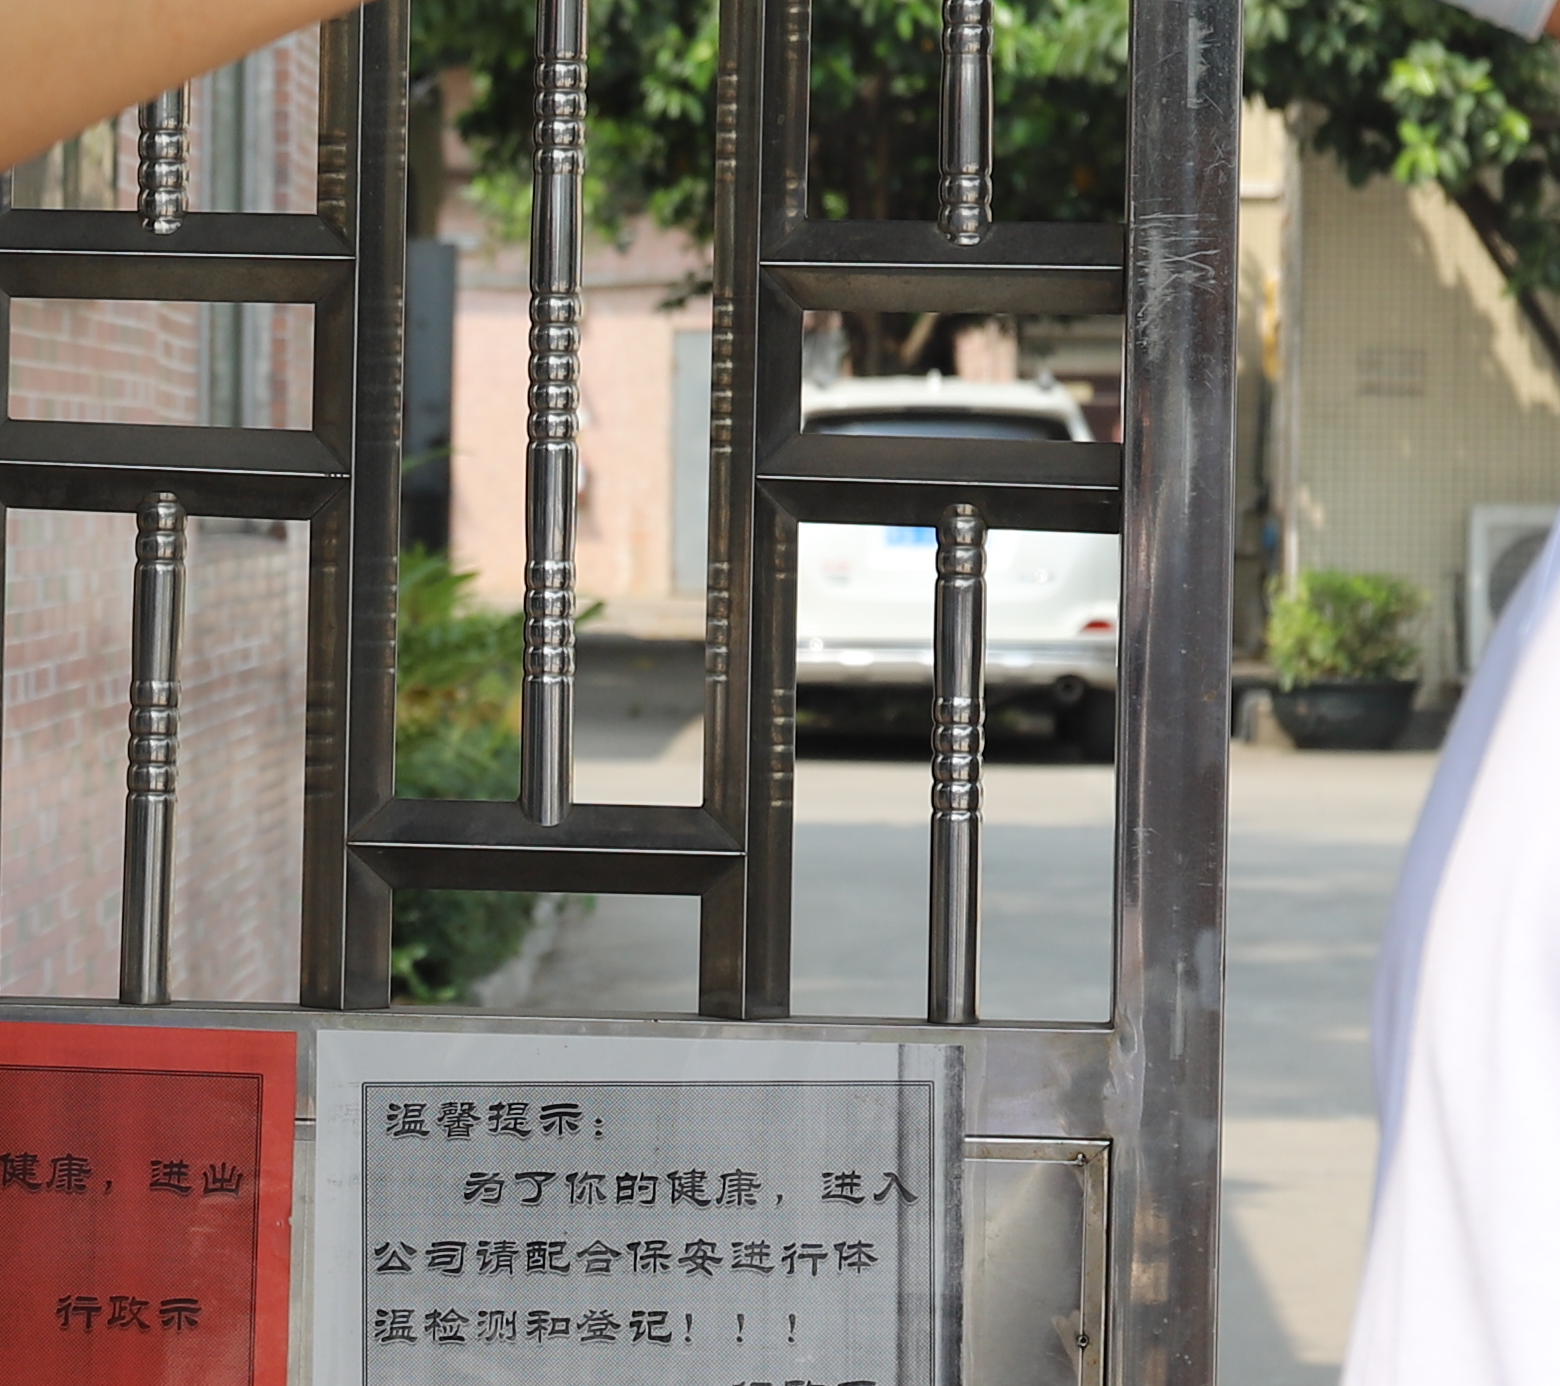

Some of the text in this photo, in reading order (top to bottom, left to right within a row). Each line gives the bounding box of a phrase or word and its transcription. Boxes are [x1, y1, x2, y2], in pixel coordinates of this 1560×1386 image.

[385, 1100, 605, 1141] 温馨提示：
[462, 1169, 919, 1208] 为了你的健康，进入
[373, 1237, 879, 1277] 公司请配合保安进行体
[54, 1294, 203, 1334] 行政示
[373, 1307, 798, 1347] 温检测和登记！！！
